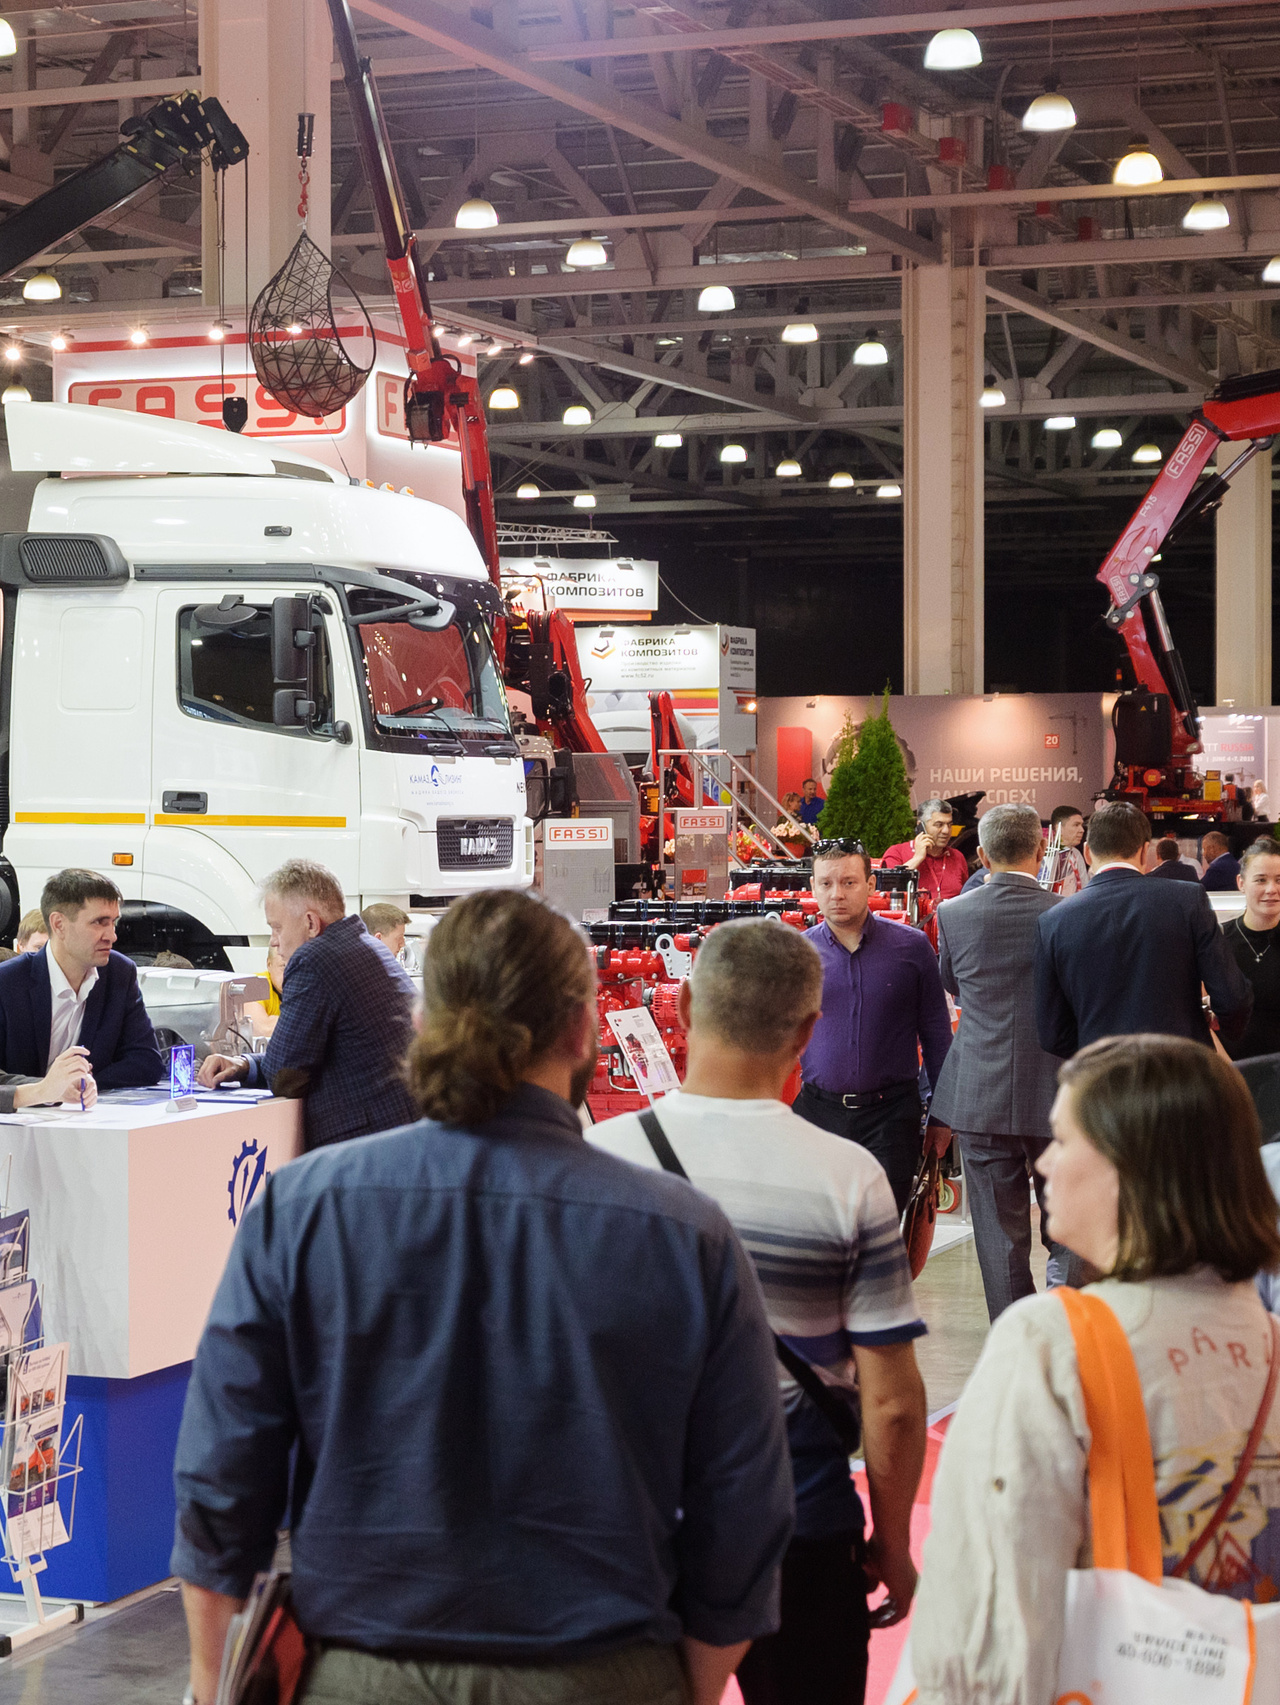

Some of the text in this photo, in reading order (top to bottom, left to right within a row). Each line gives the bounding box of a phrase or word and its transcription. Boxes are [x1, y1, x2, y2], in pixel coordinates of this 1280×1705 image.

[1169, 427, 1206, 475] FASSI
[547, 586, 644, 597] КОМПОЗИТОВ
[621, 648, 698, 657] КОМПОЗИТОВ
[1045, 735, 1059, 746] 20
[930, 767, 1083, 783] НАШИ РЕШЕНИЯ,
[683, 817, 721, 827] FASSI
[553, 829, 604, 840] FASSI
